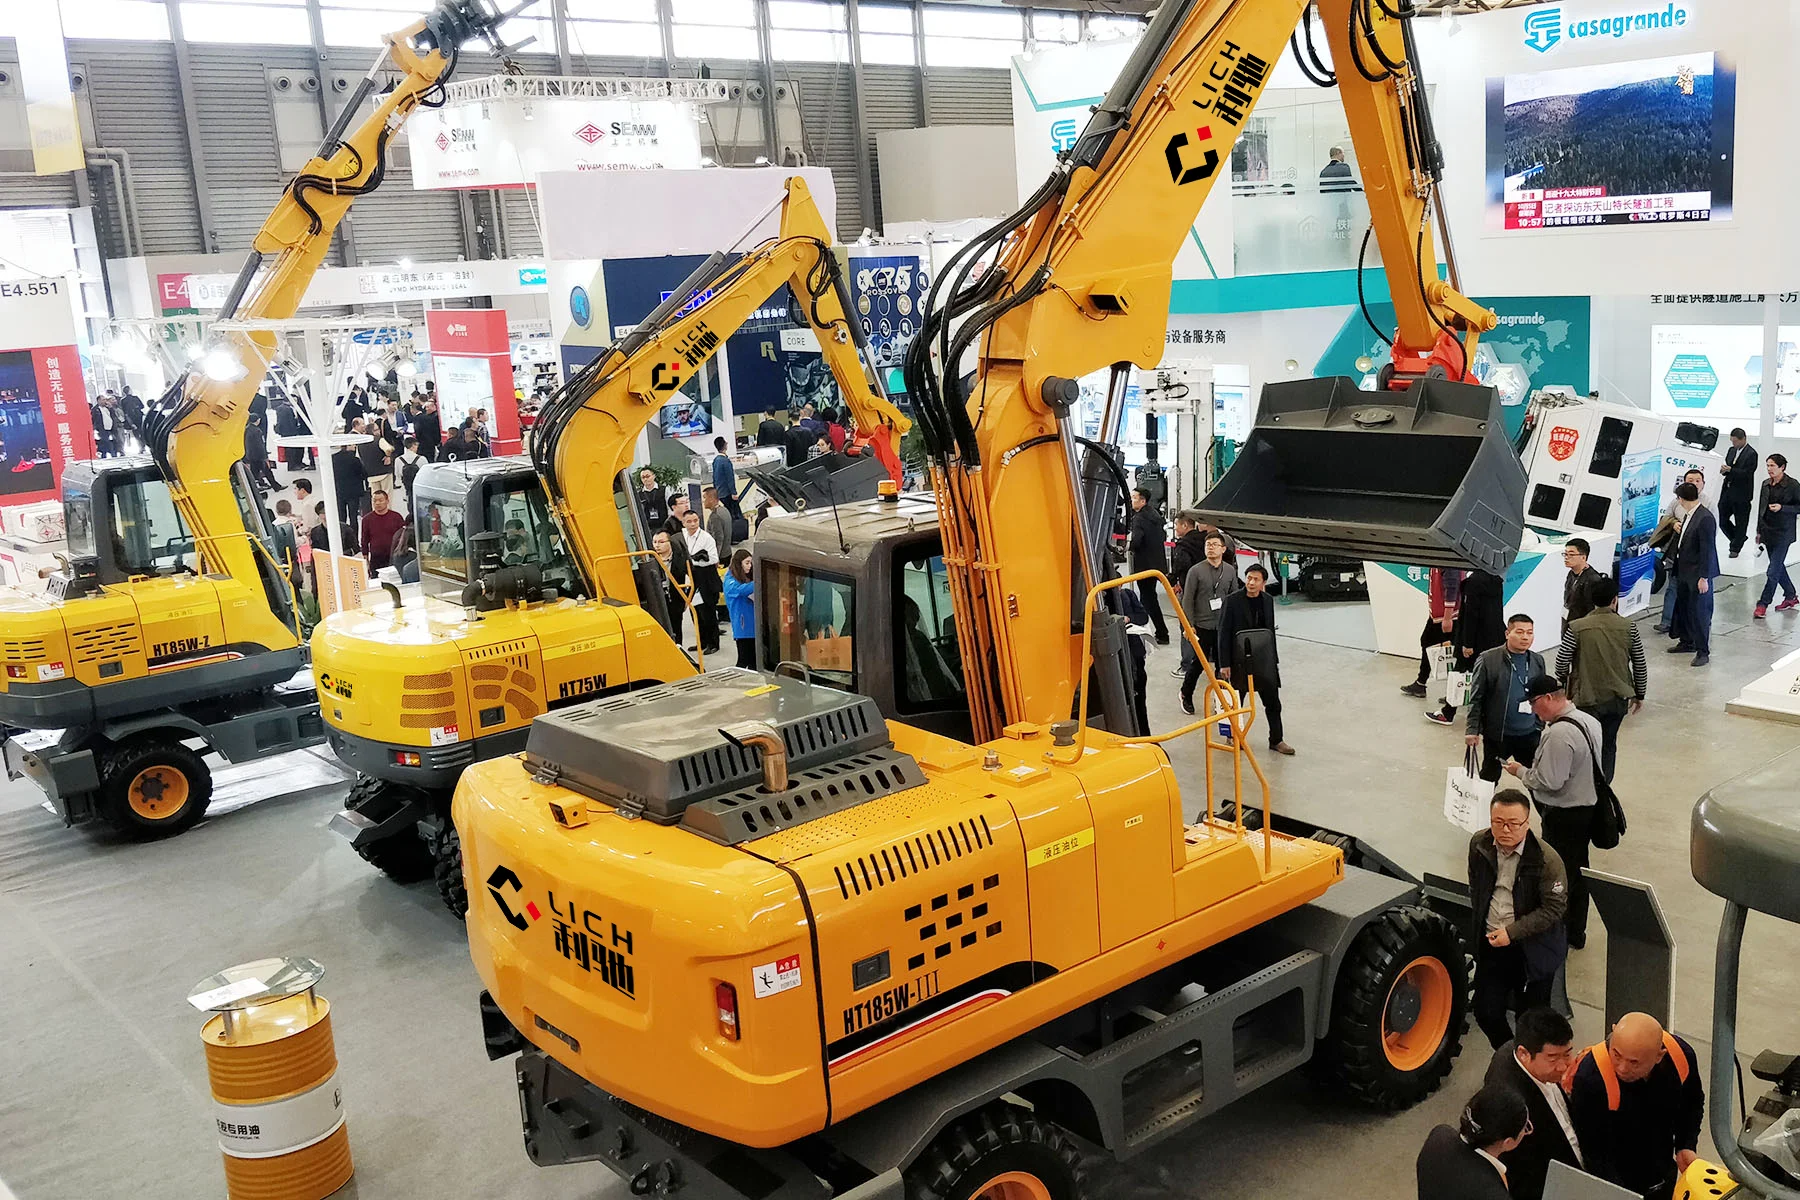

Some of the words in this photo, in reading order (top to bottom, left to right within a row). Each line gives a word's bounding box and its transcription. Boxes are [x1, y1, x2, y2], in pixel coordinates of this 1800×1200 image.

[1568, 3, 1686, 38] casagrande
[1192, 40, 1241, 109] LICH
[1518, 218, 1541, 227] 10:57
[1, 282, 59, 297] E4.551
[1496, 312, 1545, 326] sagrande
[674, 321, 708, 355] LICH
[787, 337, 806, 346] CORE
[46, 356, 68, 414] 创造无止境
[153, 635, 210, 656] HT85W-Z
[559, 673, 607, 698] HT75W
[1043, 837, 1079, 860] 液压油位
[548, 890, 633, 956] LICH
[843, 969, 942, 1036] HT185W-III
